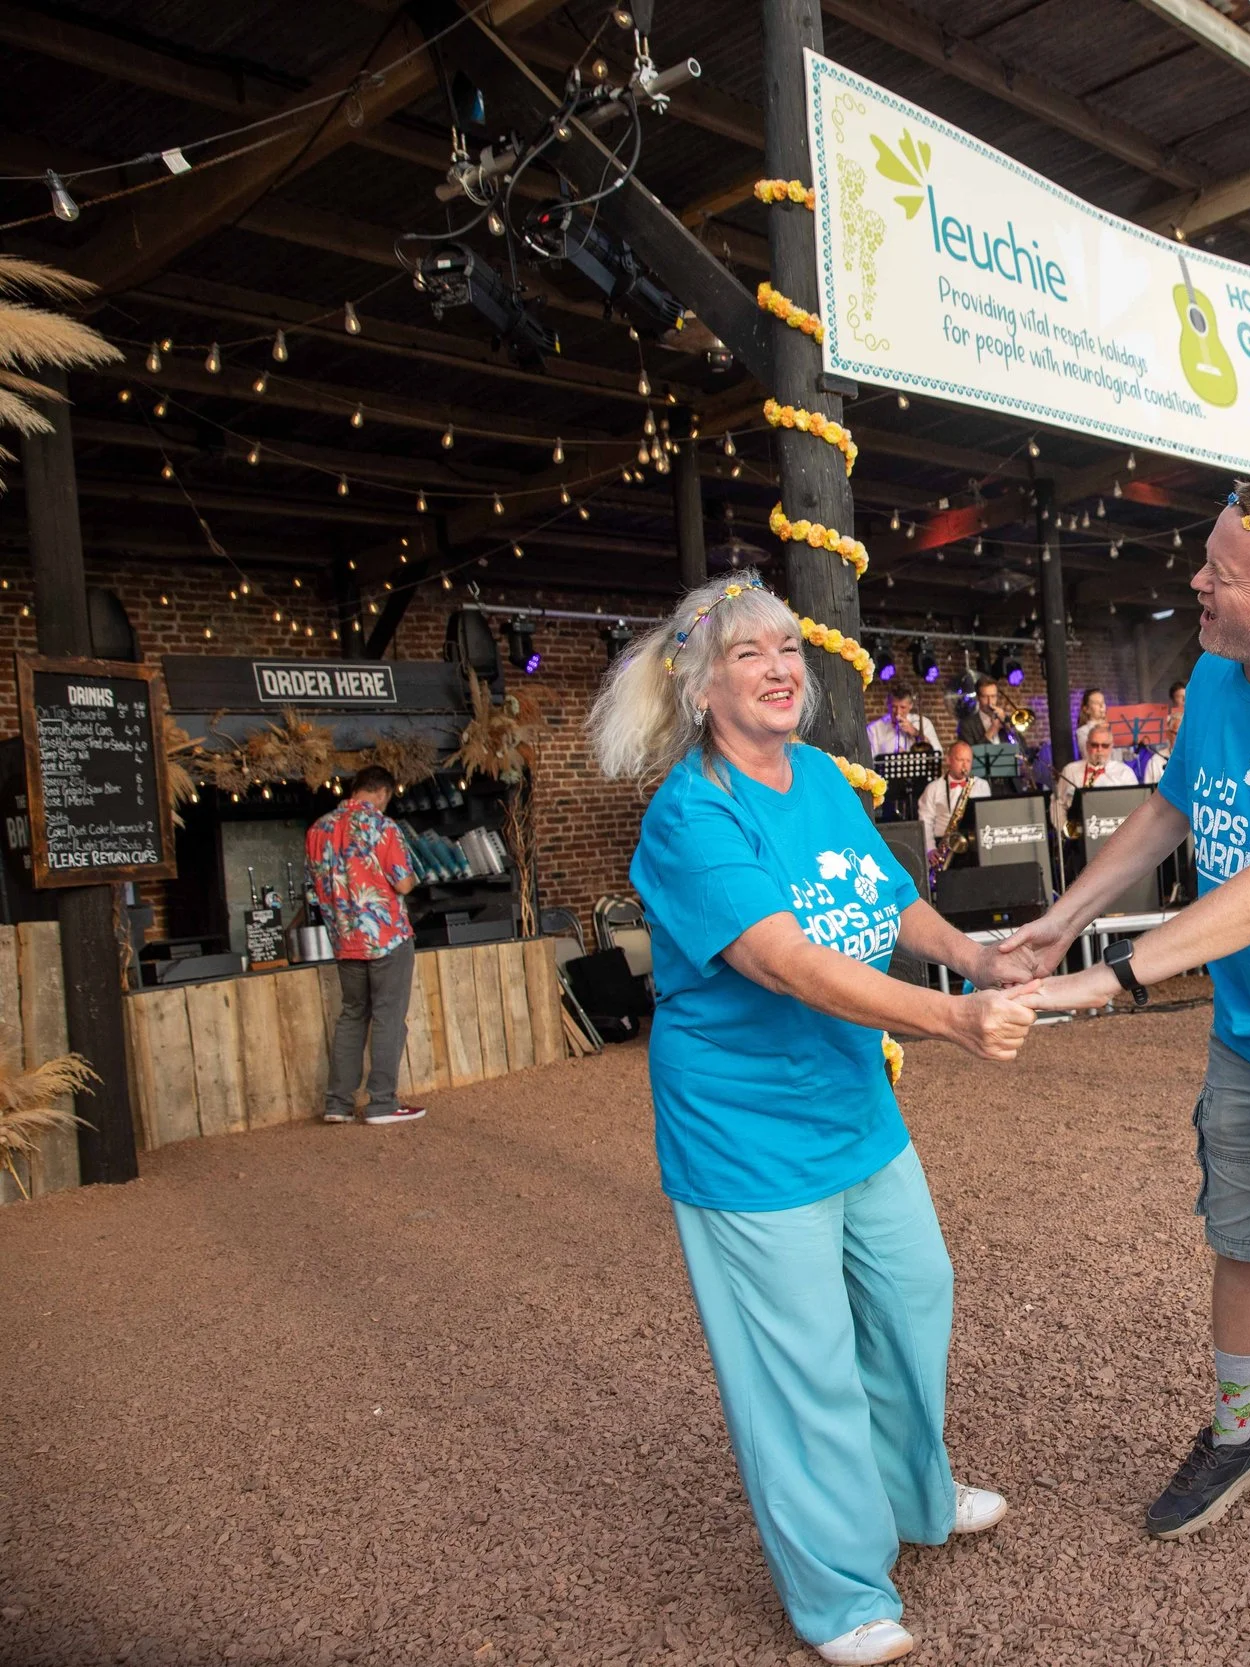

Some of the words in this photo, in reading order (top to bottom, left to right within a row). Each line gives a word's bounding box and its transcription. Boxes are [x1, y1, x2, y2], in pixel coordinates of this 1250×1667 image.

[928, 184, 1068, 302] leuchie
[938, 275, 1017, 338] Providing
[1020, 308, 1050, 339] vital
[1053, 323, 1096, 360] respite
[1098, 335, 1148, 378] holidays
[942, 314, 971, 347] for
[976, 332, 1025, 372] people
[1029, 346, 1061, 377] with
[1063, 359, 1142, 404] neurological
[1144, 387, 1206, 419] conditions.
[68, 685, 114, 707] DRINKS
[262, 669, 333, 696] ORDER
[334, 671, 389, 697] HERE
[48, 851, 89, 869] PLEASE
[91, 850, 132, 866] RETURN
[131, 849, 158, 864] CUPS
[803, 902, 870, 946] HOPS
[872, 909, 885, 922] IN
[883, 903, 899, 918] THE
